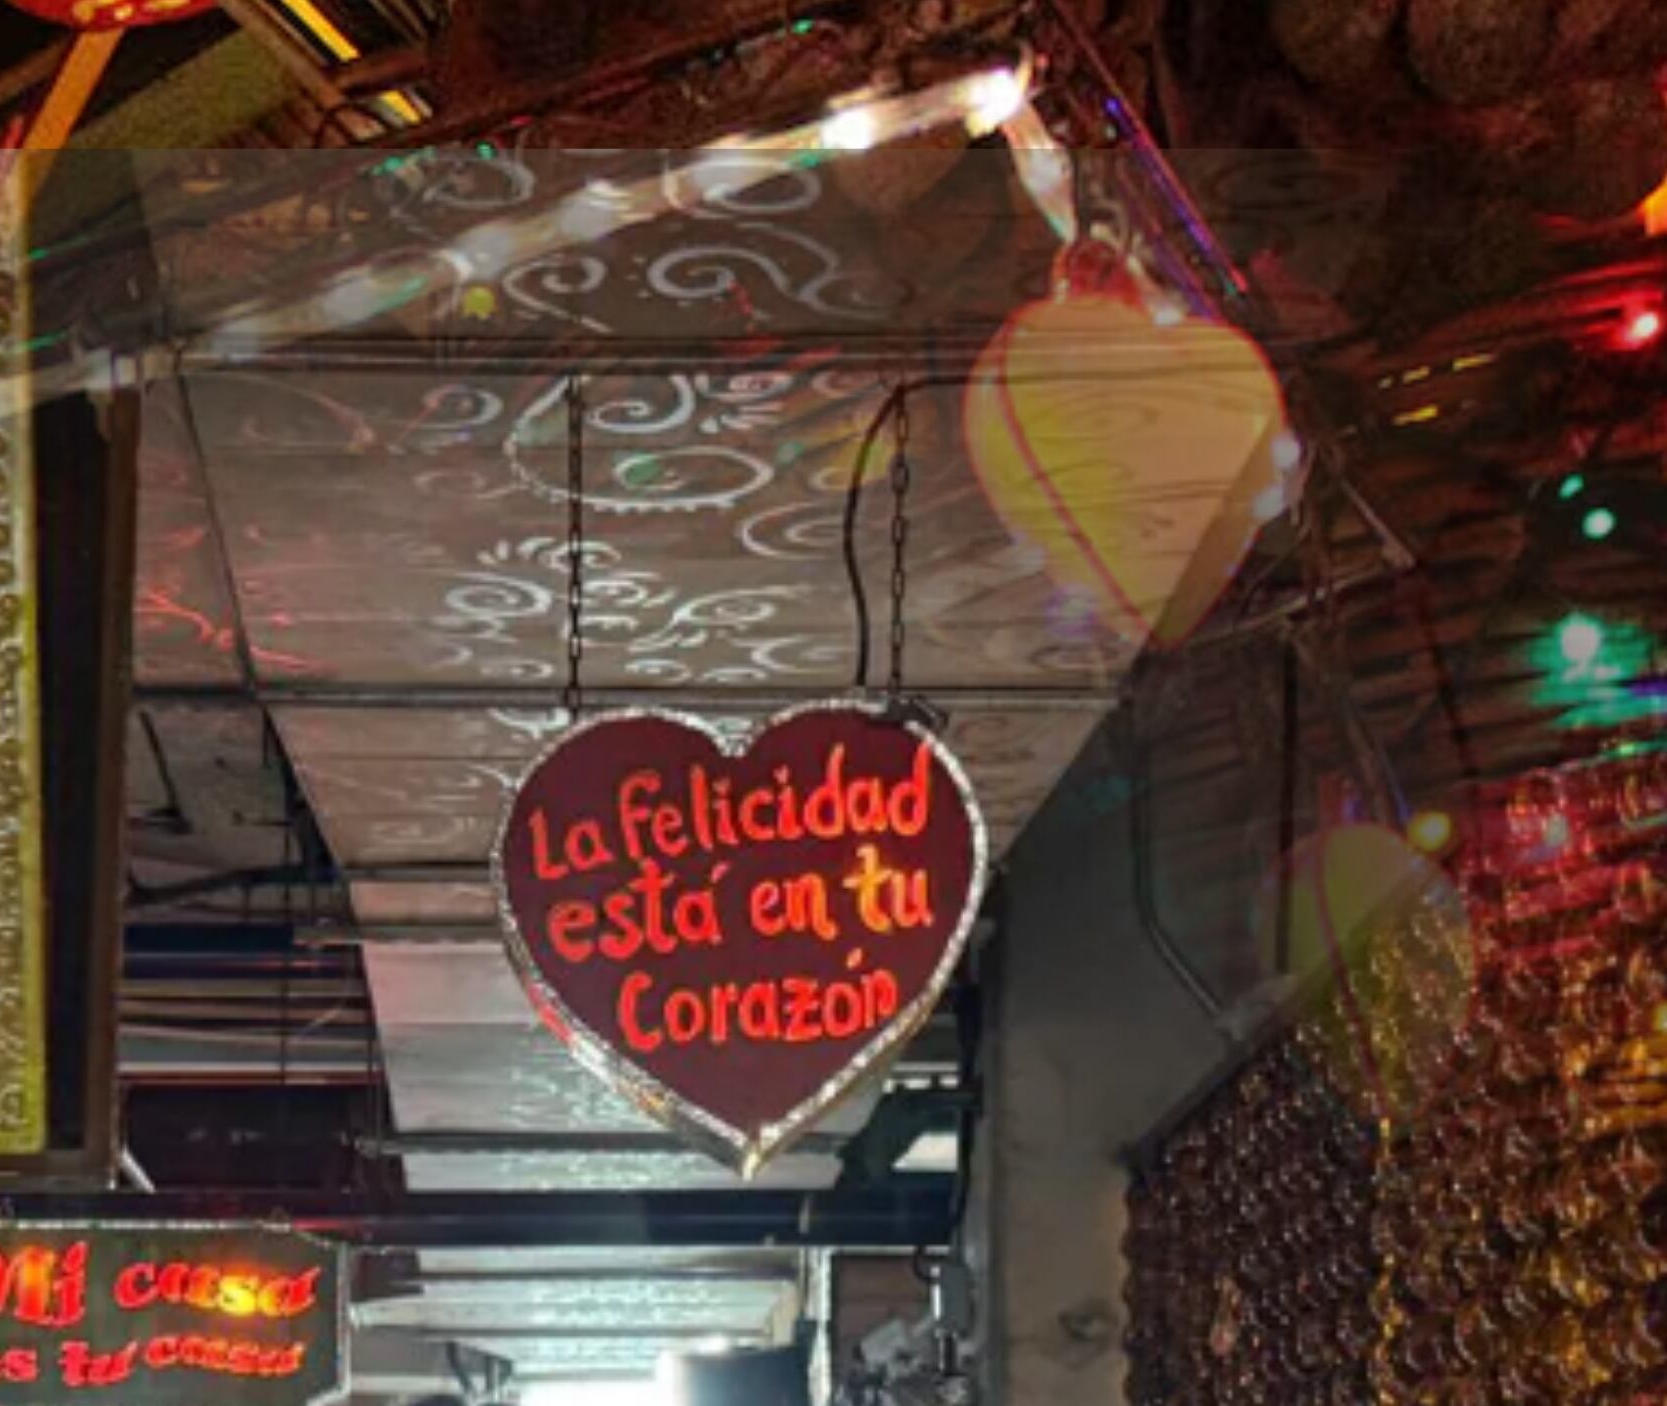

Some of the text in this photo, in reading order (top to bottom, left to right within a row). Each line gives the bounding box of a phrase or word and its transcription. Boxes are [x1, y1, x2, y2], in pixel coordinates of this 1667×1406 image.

[528, 805, 613, 881] La
[546, 844, 934, 962] está en tu
[617, 948, 899, 1053] Corazón
[114, 1260, 323, 1318] casa
[143, 1334, 306, 1377] casa
